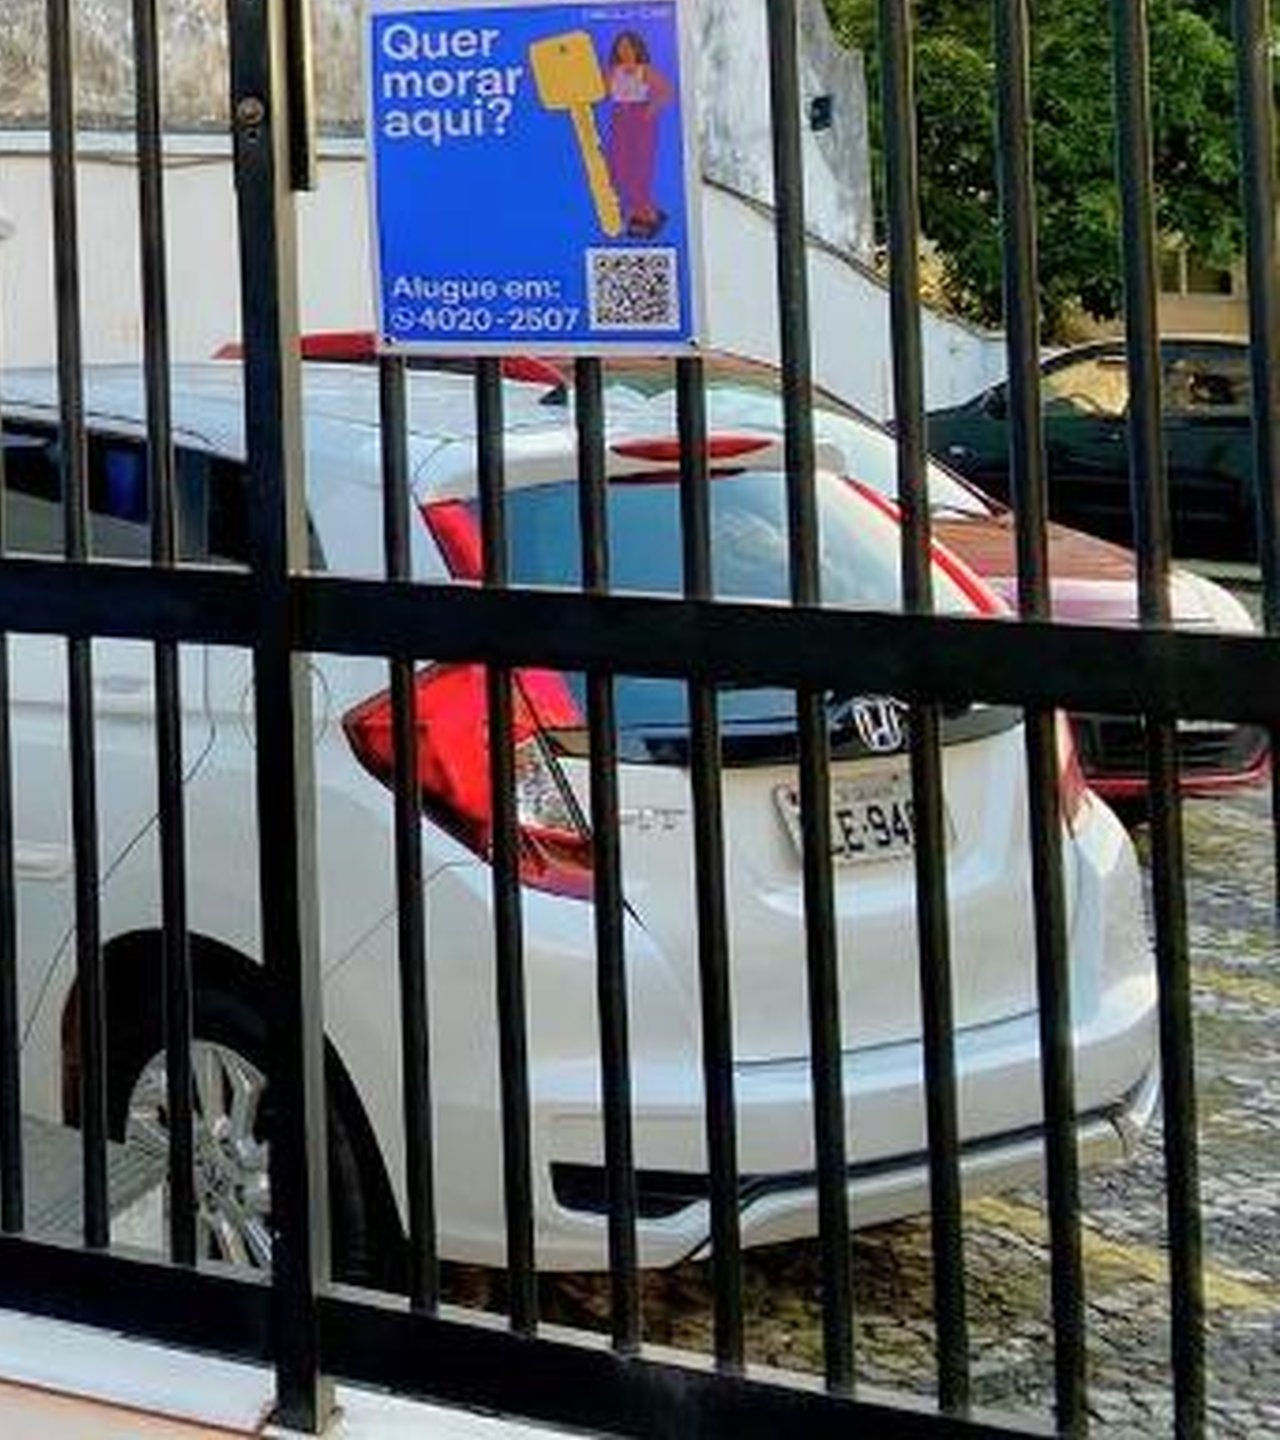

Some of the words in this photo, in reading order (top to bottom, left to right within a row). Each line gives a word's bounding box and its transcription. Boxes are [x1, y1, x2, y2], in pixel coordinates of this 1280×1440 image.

[382, 23, 500, 60] Quer
[383, 65, 524, 98] morar
[384, 98, 513, 145] aqui?
[392, 276, 498, 304] Alugue
